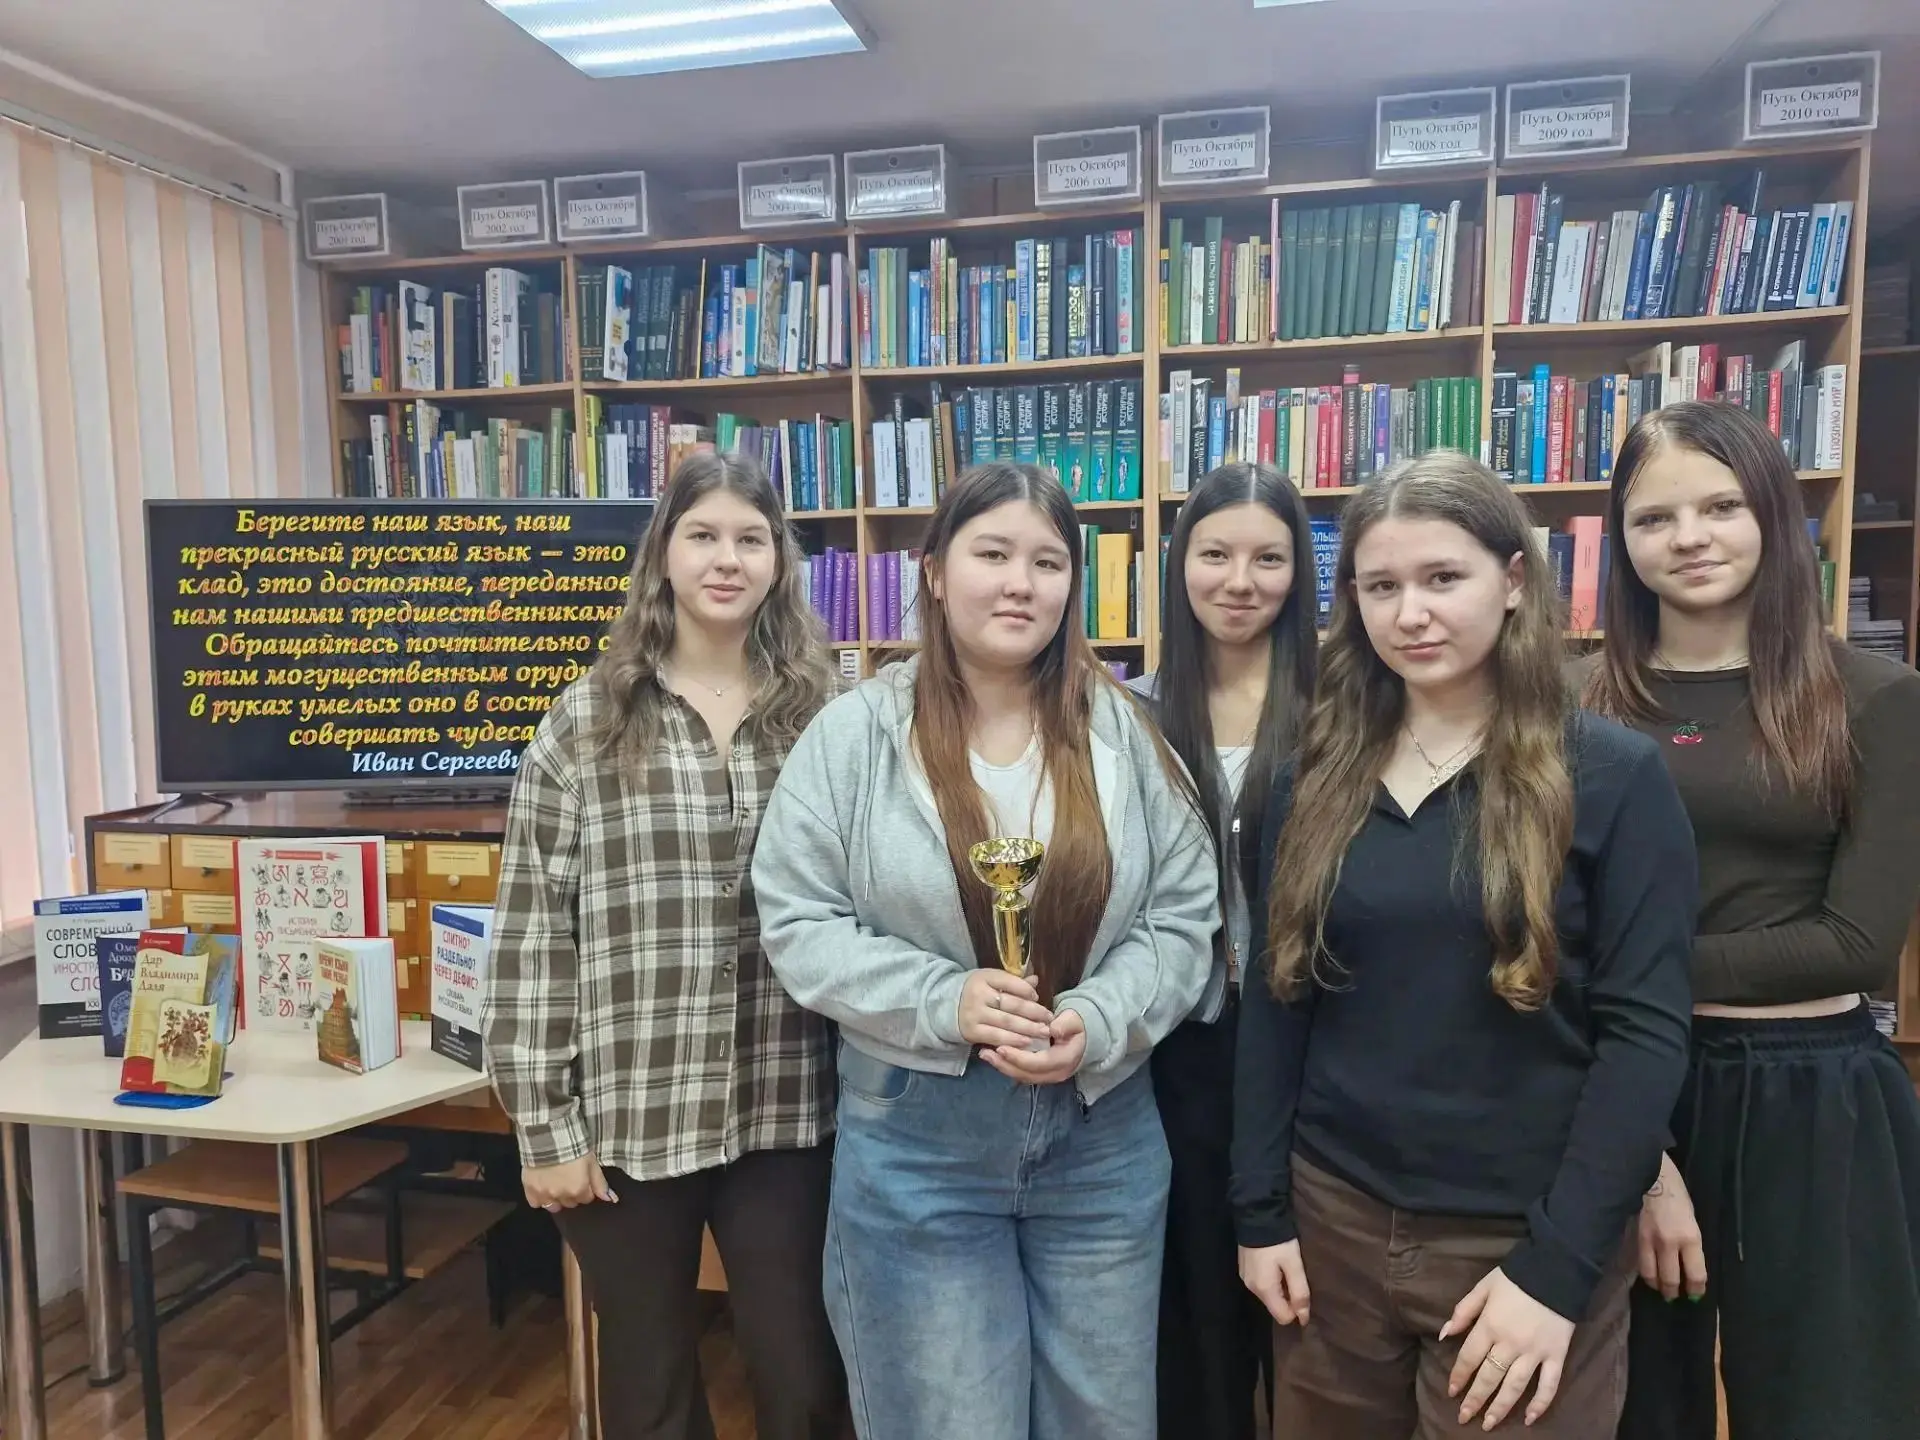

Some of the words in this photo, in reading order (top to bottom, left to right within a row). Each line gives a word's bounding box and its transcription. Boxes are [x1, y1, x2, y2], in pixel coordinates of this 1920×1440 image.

[1763, 93, 1796, 108] Путь
[1800, 87, 1859, 101] Октября
[1521, 112, 1552, 126] Путь
[1556, 109, 1611, 123] Октября
[1780, 108, 1812, 121] 2010
[1816, 110, 1840, 119] год
[1392, 123, 1421, 138] Путь
[1425, 121, 1478, 134] Октября
[1538, 128, 1567, 141] 2009
[1571, 128, 1593, 138] год
[1173, 142, 1202, 155] Путь
[1204, 139, 1254, 152] Октября
[1409, 140, 1435, 151] 2008
[1439, 139, 1461, 149] год
[1049, 163, 1076, 176] Путь
[1079, 158, 1126, 171] Октября
[1188, 158, 1215, 169] 2007
[1218, 158, 1238, 167] год
[753, 188, 775, 201] Путь
[780, 185, 823, 196] Октября
[860, 178, 885, 190] Путь
[888, 175, 931, 186] Октября
[1065, 176, 1089, 189] 2006
[1092, 176, 1111, 186] год
[472, 210, 495, 223] Путь
[497, 208, 536, 220] Октября
[569, 202, 592, 214] Путь
[595, 199, 634, 211] Октября
[1706, 232, 1719, 268] ТЕХНИКА
[1773, 252, 1786, 290] СПРАВОЧНИК
[1787, 253, 1799, 288] СПРАВОЧНИК
[1119, 386, 1127, 426] ВСЕМИРНАЯ
[1831, 387, 1841, 407] МИР
[974, 395, 982, 434] ВСЕМИРНАЯ
[981, 400, 989, 429] ИСТОРИЯ
[996, 395, 1004, 435] ВСЕМИРНАЯ
[1003, 401, 1011, 430] ИСТОРИЯ
[1068, 389, 1076, 429] ВСЕМИРНАЯ
[1075, 394, 1083, 424] ИСТОРИЯ
[1830, 410, 1841, 450] ПОЗНАЮ
[236, 509, 365, 539] Берегите
[372, 514, 428, 532] наш
[435, 514, 507, 535] язык,
[515, 514, 571, 532] наш
[180, 541, 345, 570] прекрасный
[350, 541, 459, 569] русский
[464, 544, 531, 562] язык
[573, 544, 626, 562] это
[178, 570, 250, 598] клад,
[256, 576, 312, 594] это
[320, 569, 474, 597] достояние,
[481, 569, 632, 599] переданное
[172, 607, 227, 625] нам
[233, 606, 344, 625] нашими
[205, 632, 398, 662] Обращайтесь
[406, 634, 590, 653] почтительно
[598, 635, 610, 651] с
[182, 668, 258, 686] этим
[264, 660, 508, 692] могущественным
[189, 693, 206, 717] в
[211, 697, 293, 723] руках
[299, 697, 401, 722] умелых
[408, 695, 456, 713] оно
[464, 690, 480, 713] в
[486, 695, 560, 712] сост
[289, 722, 440, 751] совершать
[447, 719, 536, 749] чудеса
[351, 751, 414, 772] Иван
[443, 930, 470, 951] СЛИТНО?
[141, 953, 162, 968] Дар
[437, 946, 476, 973] РАЗДЕЛЬНО?
[140, 968, 199, 982] Владимира
[434, 961, 452, 981] ЧЕРЕЗ
[453, 970, 479, 991] ДЕФИС?
[138, 980, 165, 992] Даля
